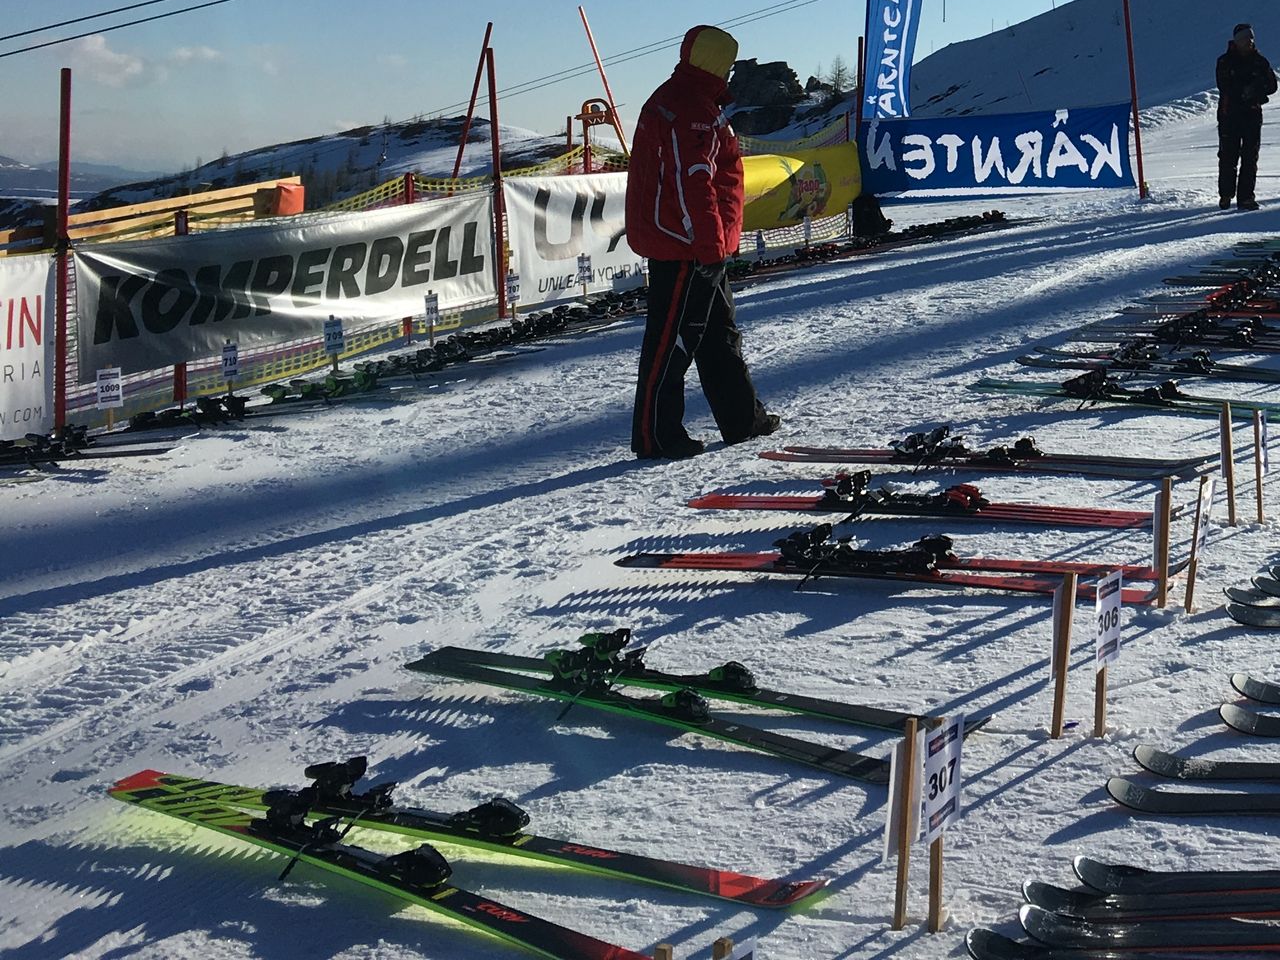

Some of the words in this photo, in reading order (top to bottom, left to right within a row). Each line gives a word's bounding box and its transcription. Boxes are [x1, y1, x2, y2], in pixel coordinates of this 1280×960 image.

[92, 221, 485, 346] KOMPERDELL
[508, 283, 519, 294] 707
[538, 270, 596, 293] UNLEA
[600, 263, 632, 281] YOUR
[0, 295, 42, 350] IN
[326, 329, 343, 342] 709
[3, 359, 42, 383] RIA
[224, 355, 237, 368] 710
[100, 382, 121, 394] 1009
[0, 406, 43, 425] N.COM
[1097, 606, 1119, 636] 306
[928, 757, 957, 801] 307
